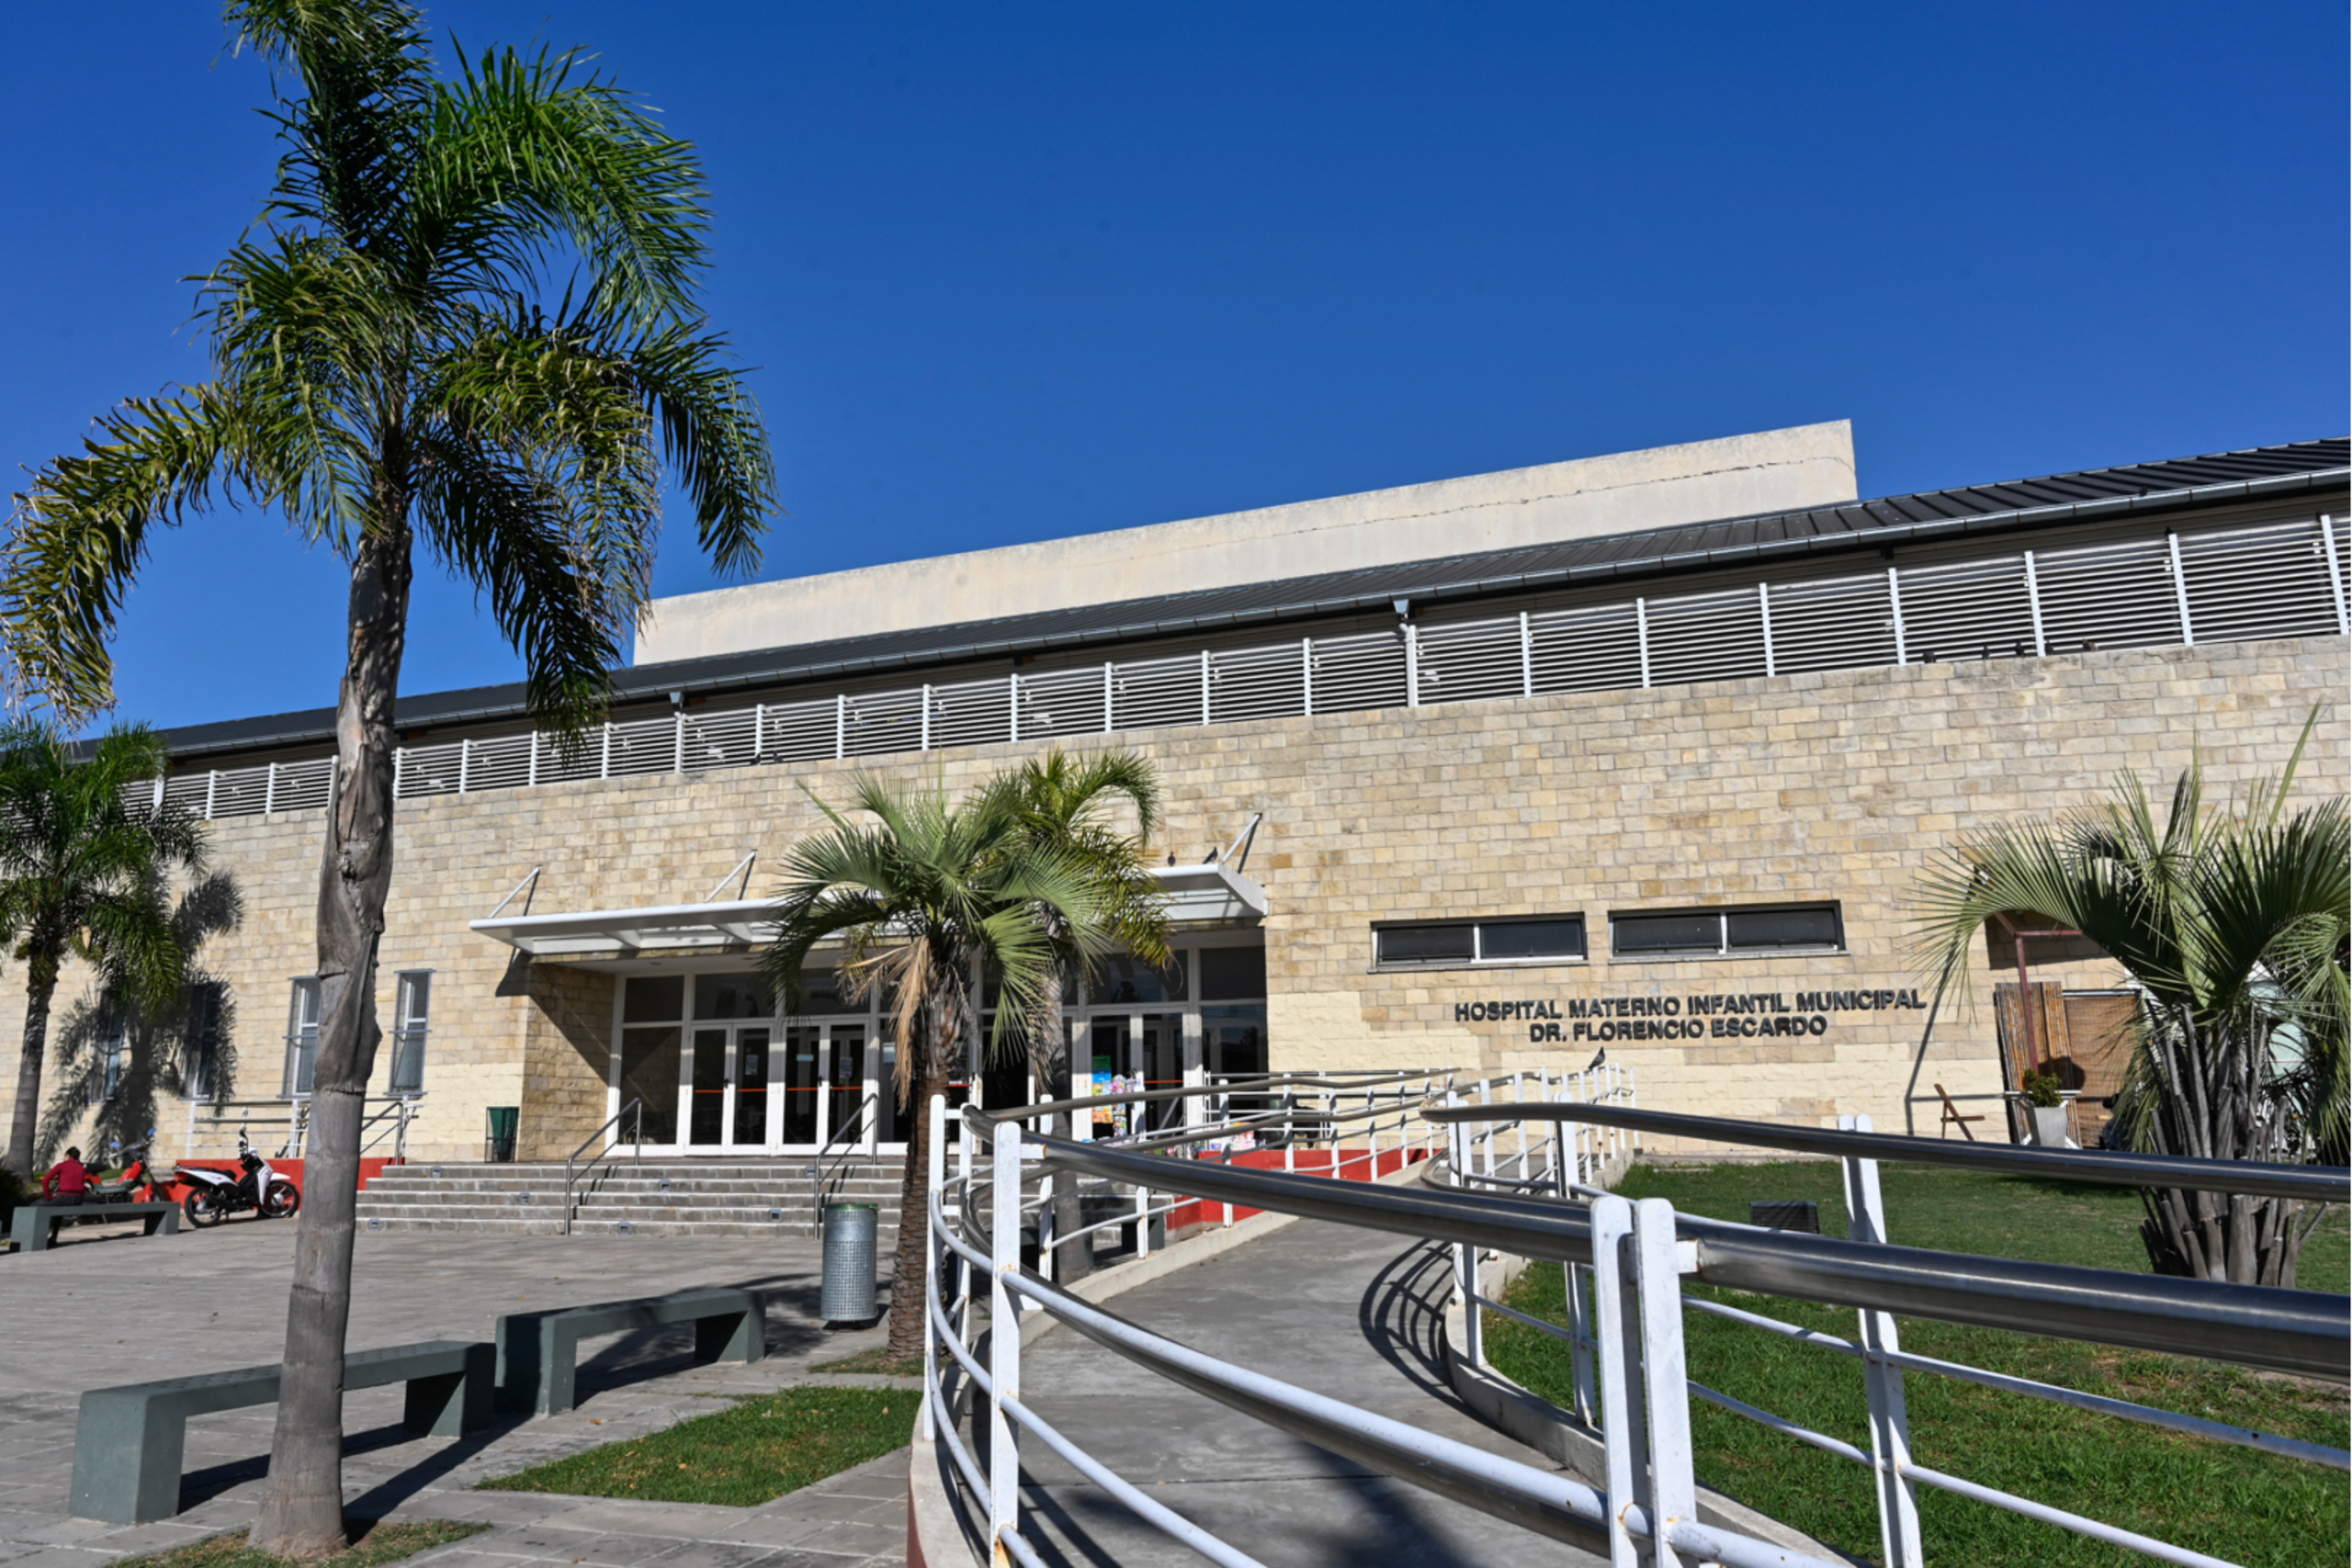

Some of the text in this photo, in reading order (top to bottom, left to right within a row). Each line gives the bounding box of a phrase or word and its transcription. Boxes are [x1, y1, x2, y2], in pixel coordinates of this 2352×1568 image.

[1454, 988, 1928, 1021] HOSPITAL MATERNO INFANTIL MUNICIPAL
[1530, 1015, 1827, 1043] DR. FLORENCIO ESCARDO
